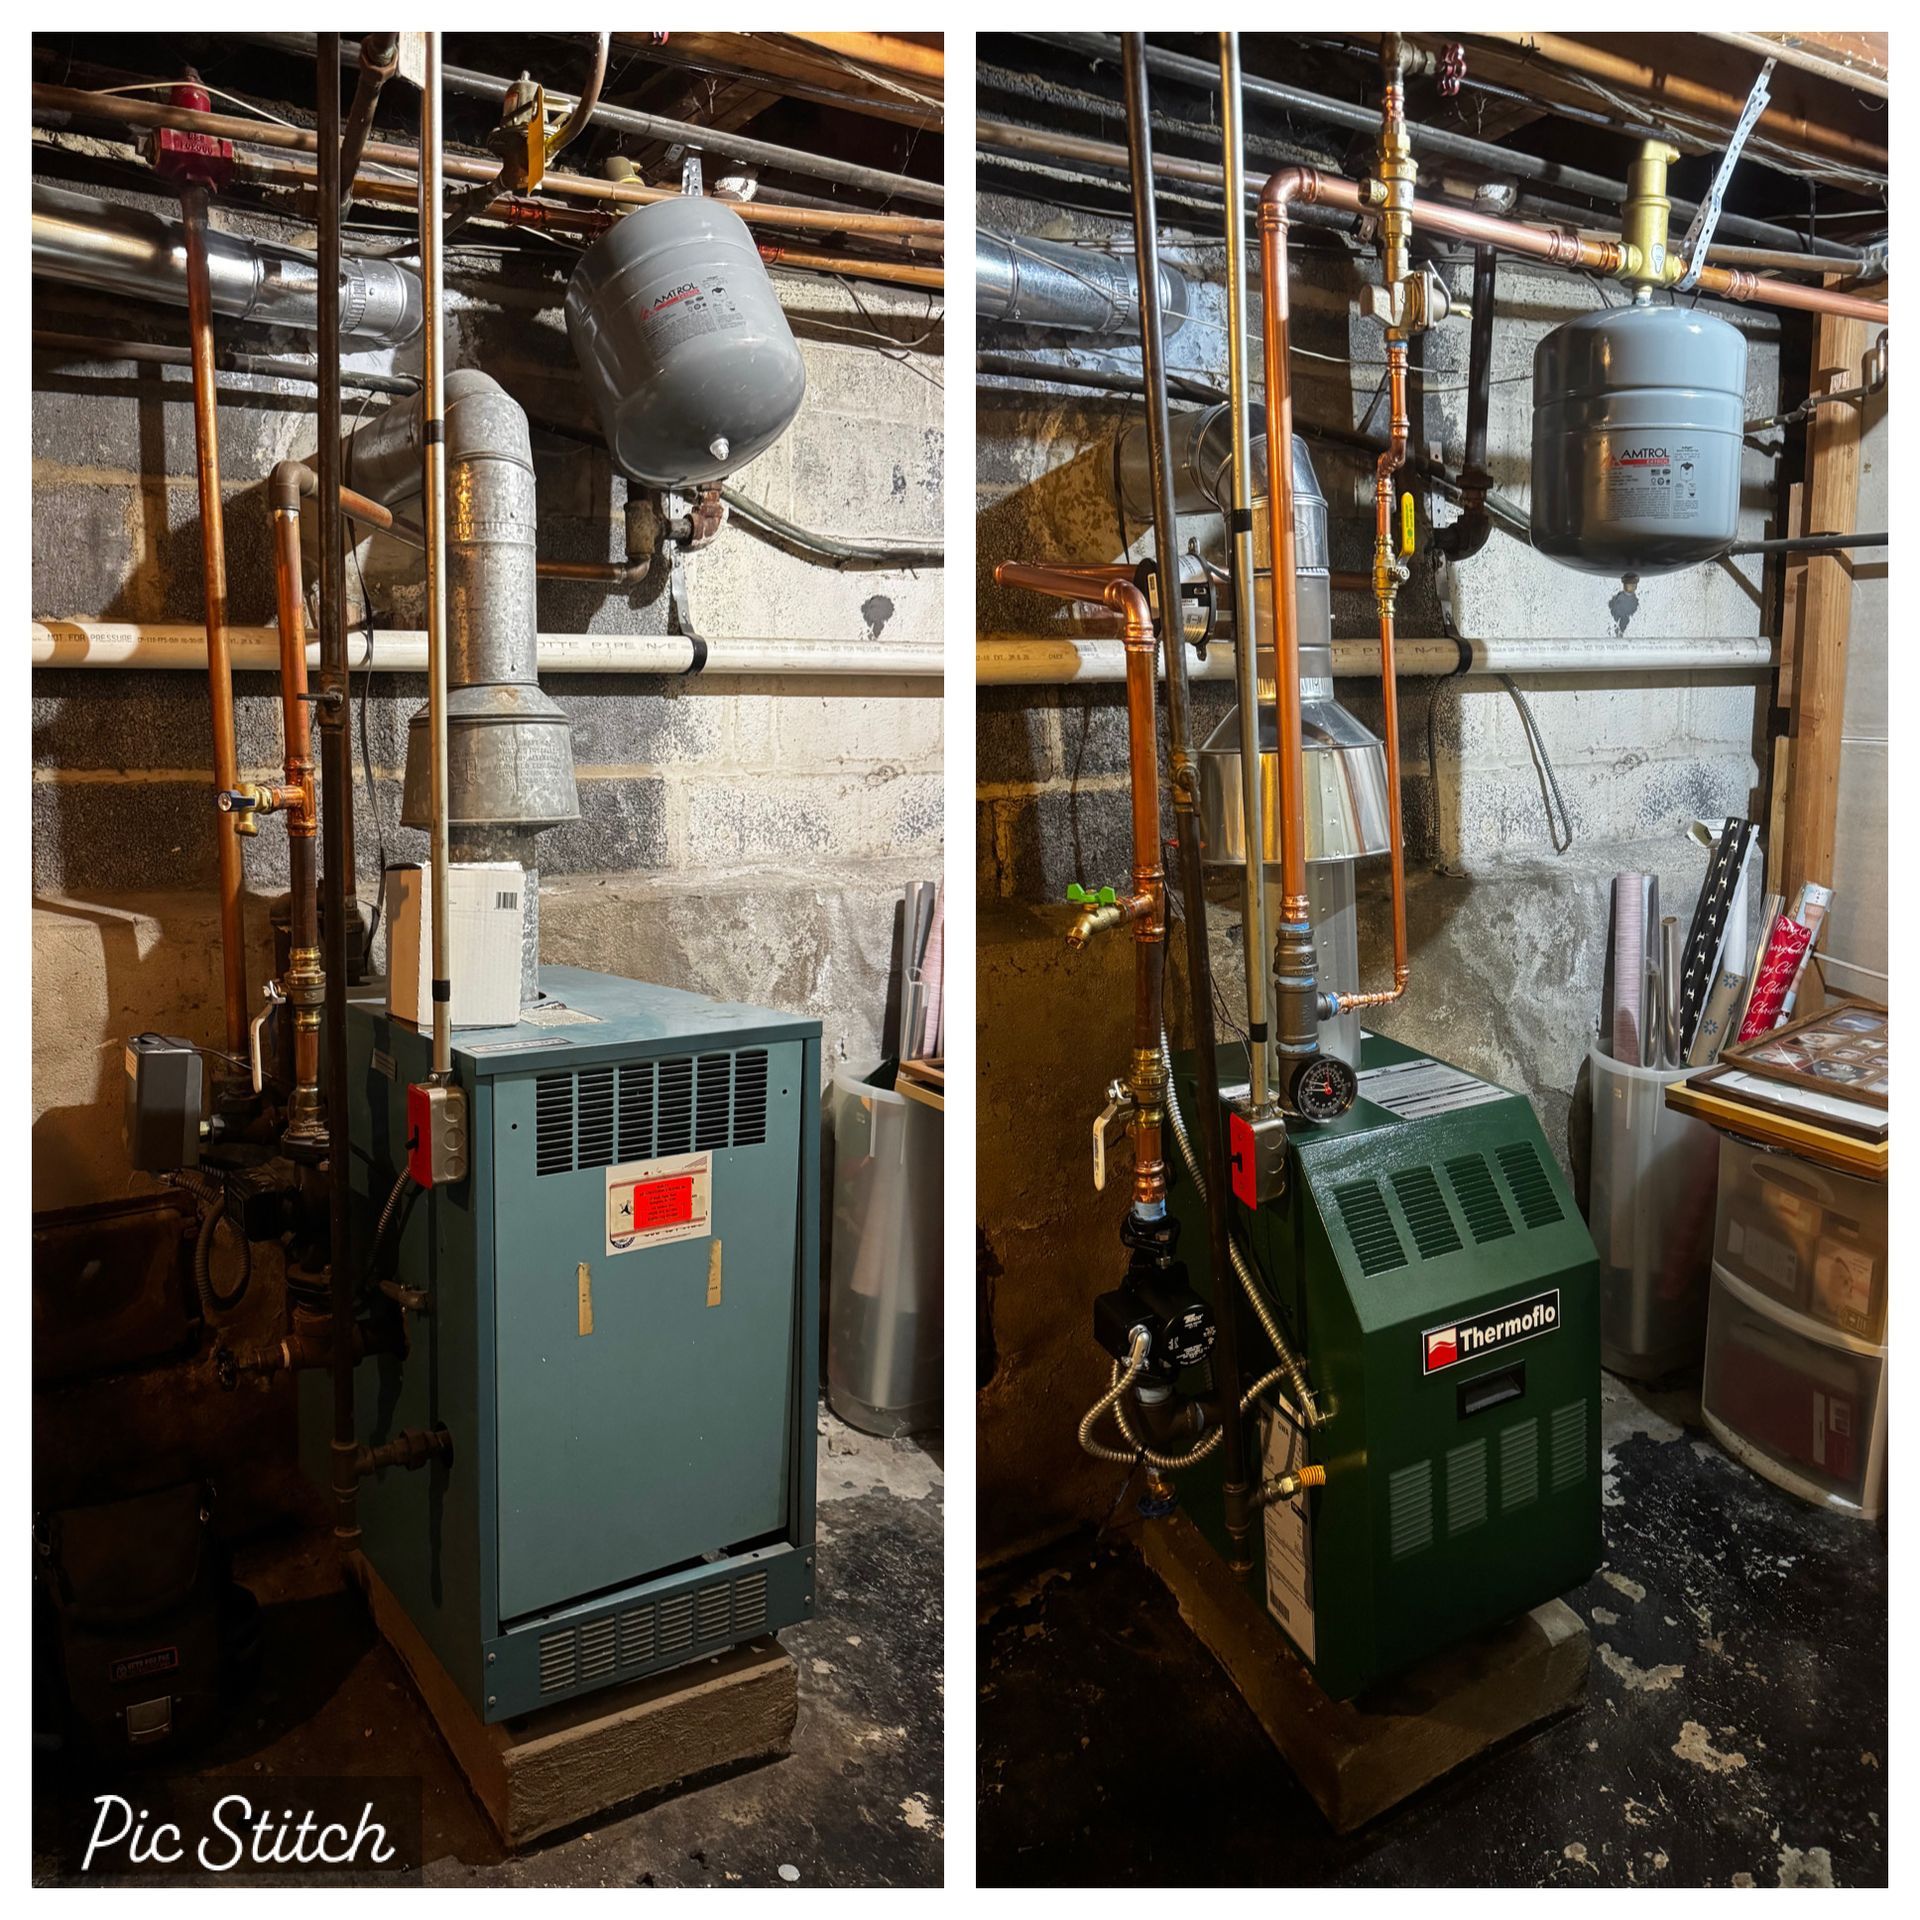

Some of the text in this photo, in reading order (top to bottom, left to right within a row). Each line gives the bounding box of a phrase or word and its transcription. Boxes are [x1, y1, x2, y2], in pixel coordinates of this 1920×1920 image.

[653, 282, 698, 308] AMTROL
[1620, 447, 1671, 459] AMTROL
[47, 633, 63, 641] NOT
[68, 633, 86, 642] FOR
[90, 633, 133, 643] PRESSURE
[591, 641, 636, 650] PIPE
[1362, 647, 1404, 656] PIE
[1459, 1304, 1556, 1352] Thermoflo
